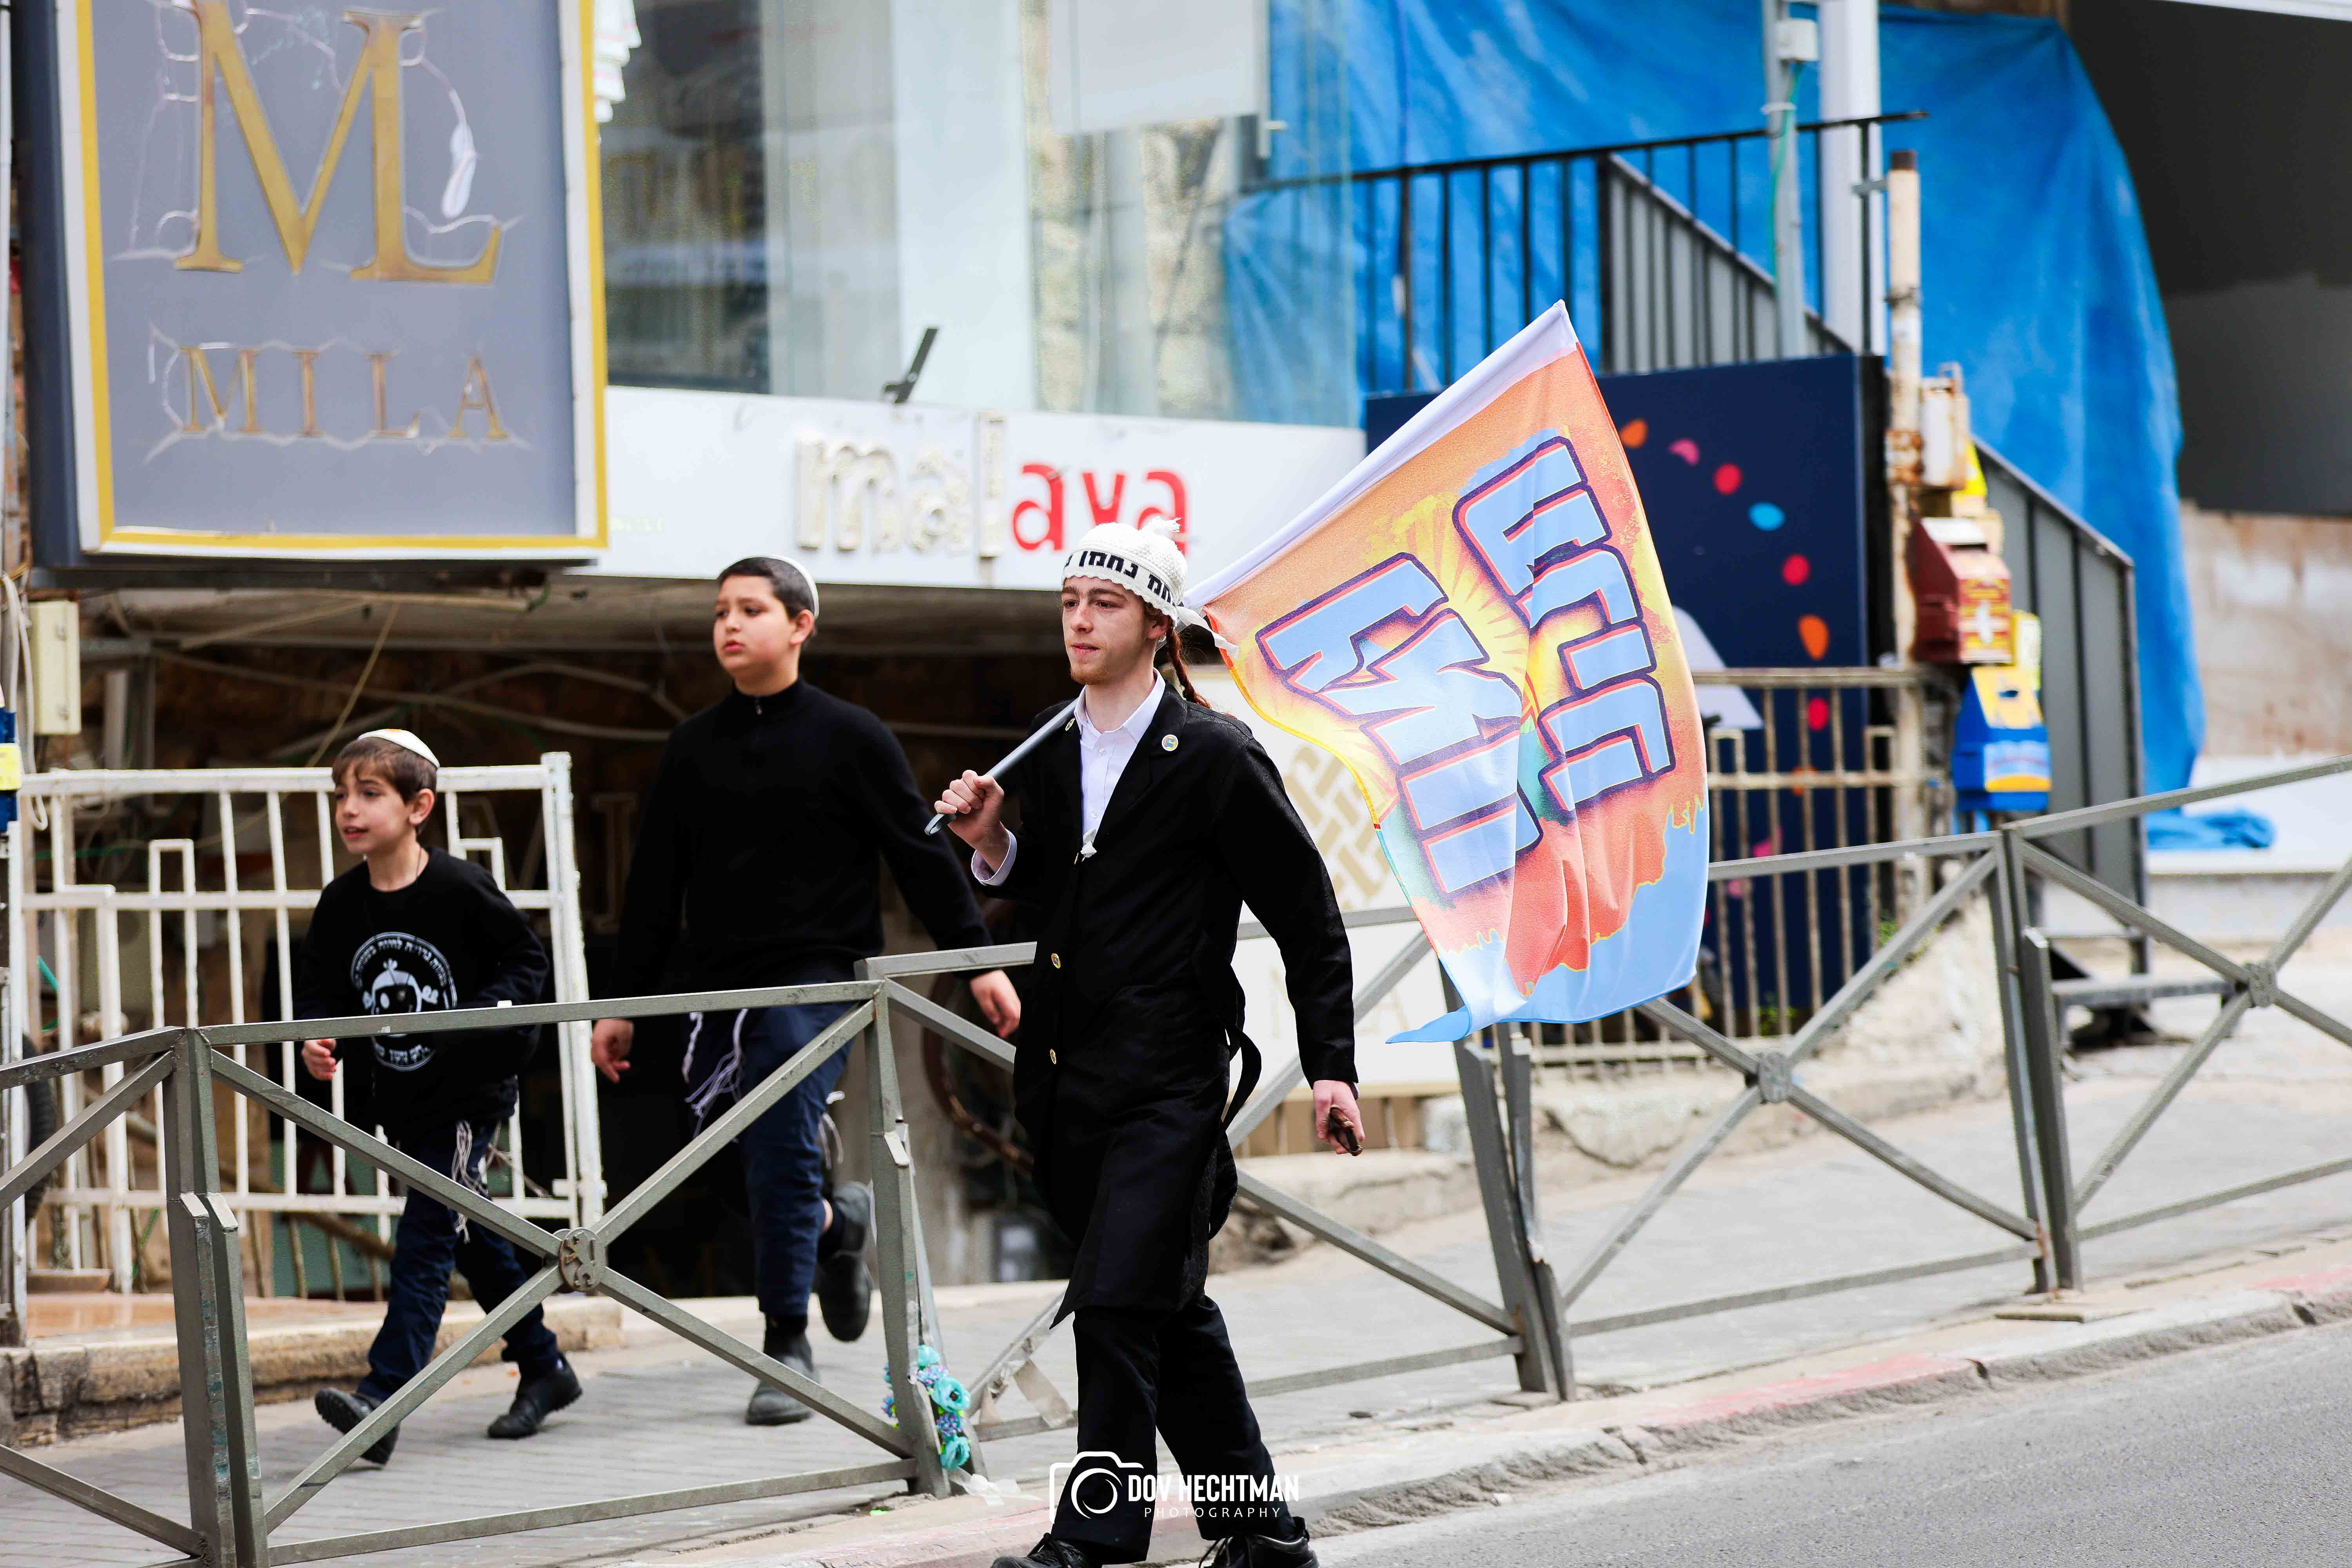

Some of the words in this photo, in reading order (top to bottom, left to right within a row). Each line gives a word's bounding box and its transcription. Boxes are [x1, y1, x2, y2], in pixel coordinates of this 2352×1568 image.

[180, 346, 509, 439] MILA
[1079, 551, 1139, 579] נחמן
[1147, 573, 1176, 607] חמ
